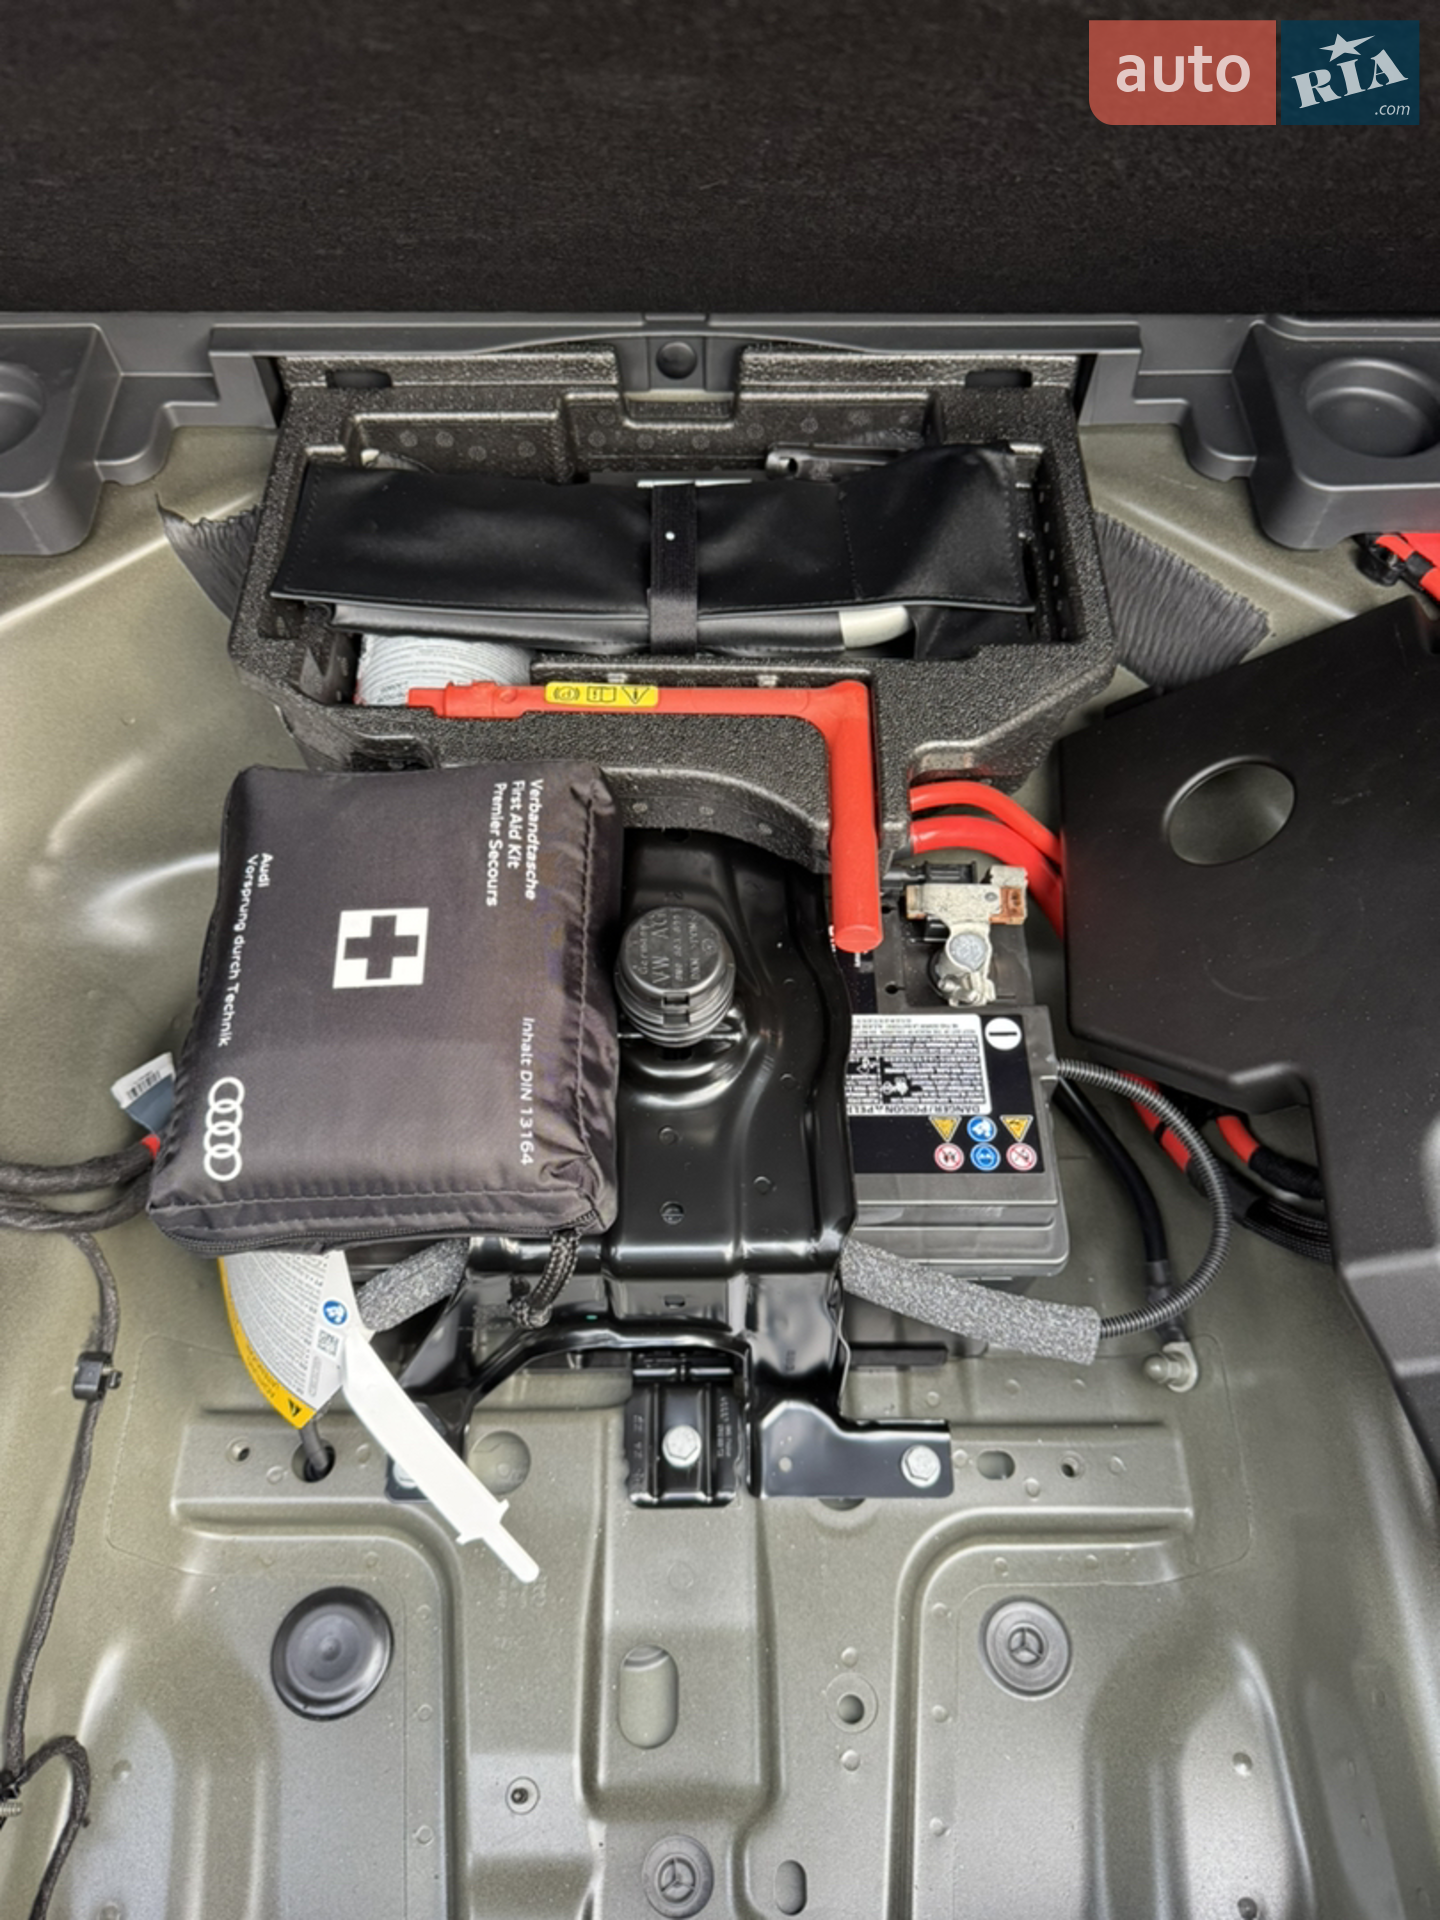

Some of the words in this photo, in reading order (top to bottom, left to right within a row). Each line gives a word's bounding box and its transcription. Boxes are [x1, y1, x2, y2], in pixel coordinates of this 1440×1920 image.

[489, 782, 508, 836] Premier
[510, 780, 525, 810] First
[508, 813, 523, 840] Aid
[525, 779, 544, 900] Verbandtasche
[257, 853, 273, 888] Audi
[486, 839, 504, 906] Secours
[507, 844, 522, 869] Kit
[233, 854, 259, 932] Vorsprung
[228, 934, 246, 980] durch
[218, 982, 240, 1047] Technik
[520, 1017, 535, 1067] Inhalt
[520, 1070, 534, 1101] DIN
[520, 1107, 535, 1165] 13164
